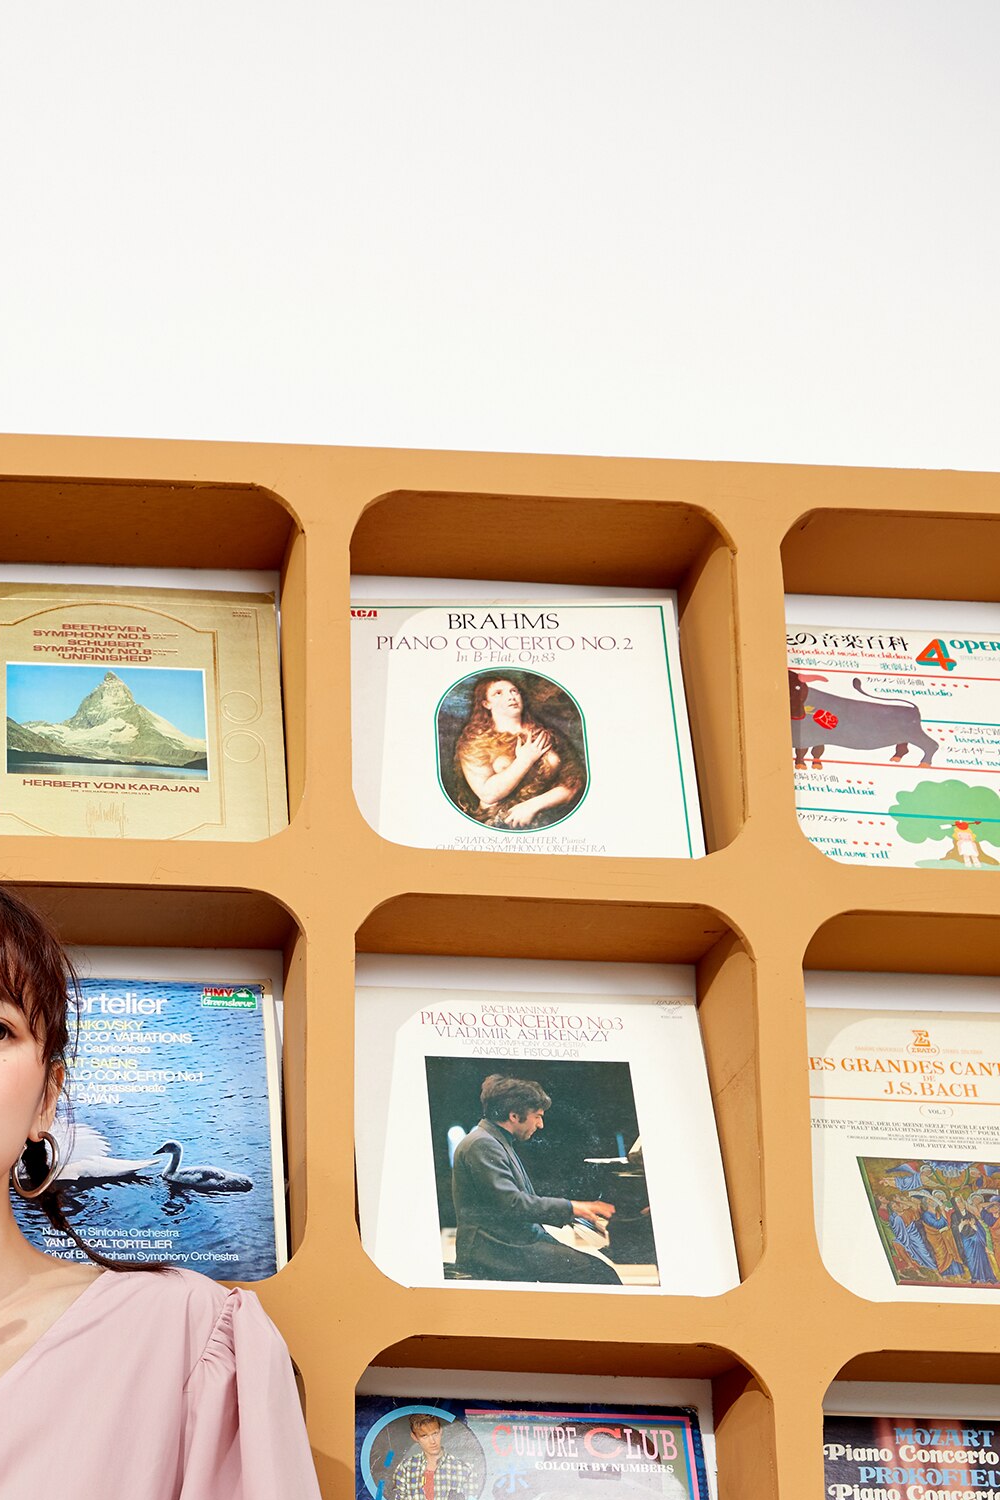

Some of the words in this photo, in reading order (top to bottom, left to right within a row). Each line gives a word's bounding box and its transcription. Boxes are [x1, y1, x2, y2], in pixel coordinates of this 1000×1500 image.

[447, 612, 560, 630] BRAHMS
[62, 623, 147, 633] BEETHOVEN
[33, 629, 116, 639] SYMPHONY
[117, 632, 152, 640] NO.5
[67, 639, 144, 648] SCHUBERT
[376, 635, 448, 651] PIANO
[455, 635, 575, 651] CONCERTO
[33, 645, 116, 654] SYMPHONY
[456, 651, 468, 662] In
[22, 779, 91, 789] HERBERT
[92, 781, 126, 790] VON
[128, 783, 200, 794] KARAJAN
[204, 987, 233, 997] HMV
[481, 1004, 560, 1015] RACHMANINOV
[420, 1011, 477, 1027] PIANO
[481, 1013, 583, 1029] CONCERTO
[112, 1032, 193, 1044] VARIATIONS
[435, 1026, 511, 1040] VLADIMIR
[517, 1028, 610, 1042] ASHKENAZY
[83, 1043, 151, 1056] Capriccioso
[472, 1047, 519, 1056] ANATOLE
[523, 1048, 580, 1058] FISTOULARI
[841, 1057, 945, 1075] GRANDES
[95, 1070, 176, 1082] CONCERTO
[77, 1093, 120, 1105] SWAN
[87, 1227, 129, 1237] Sinfonia
[129, 1228, 179, 1238] Orchestra
[43, 1238, 66, 1248] YAN
[109, 1239, 172, 1249] TORTELIER
[137, 1251, 189, 1263] Symphony
[190, 1251, 239, 1262] Orchestra
[491, 1424, 579, 1459] CULTURE
[583, 1427, 678, 1461] CLUB
[893, 1427, 995, 1448] MOZART
[823, 1443, 893, 1463] Piano
[898, 1445, 1000, 1465] Concerto
[534, 1461, 589, 1473] COLOUR
[590, 1462, 610, 1473] BY
[611, 1463, 675, 1475] NUMBERS
